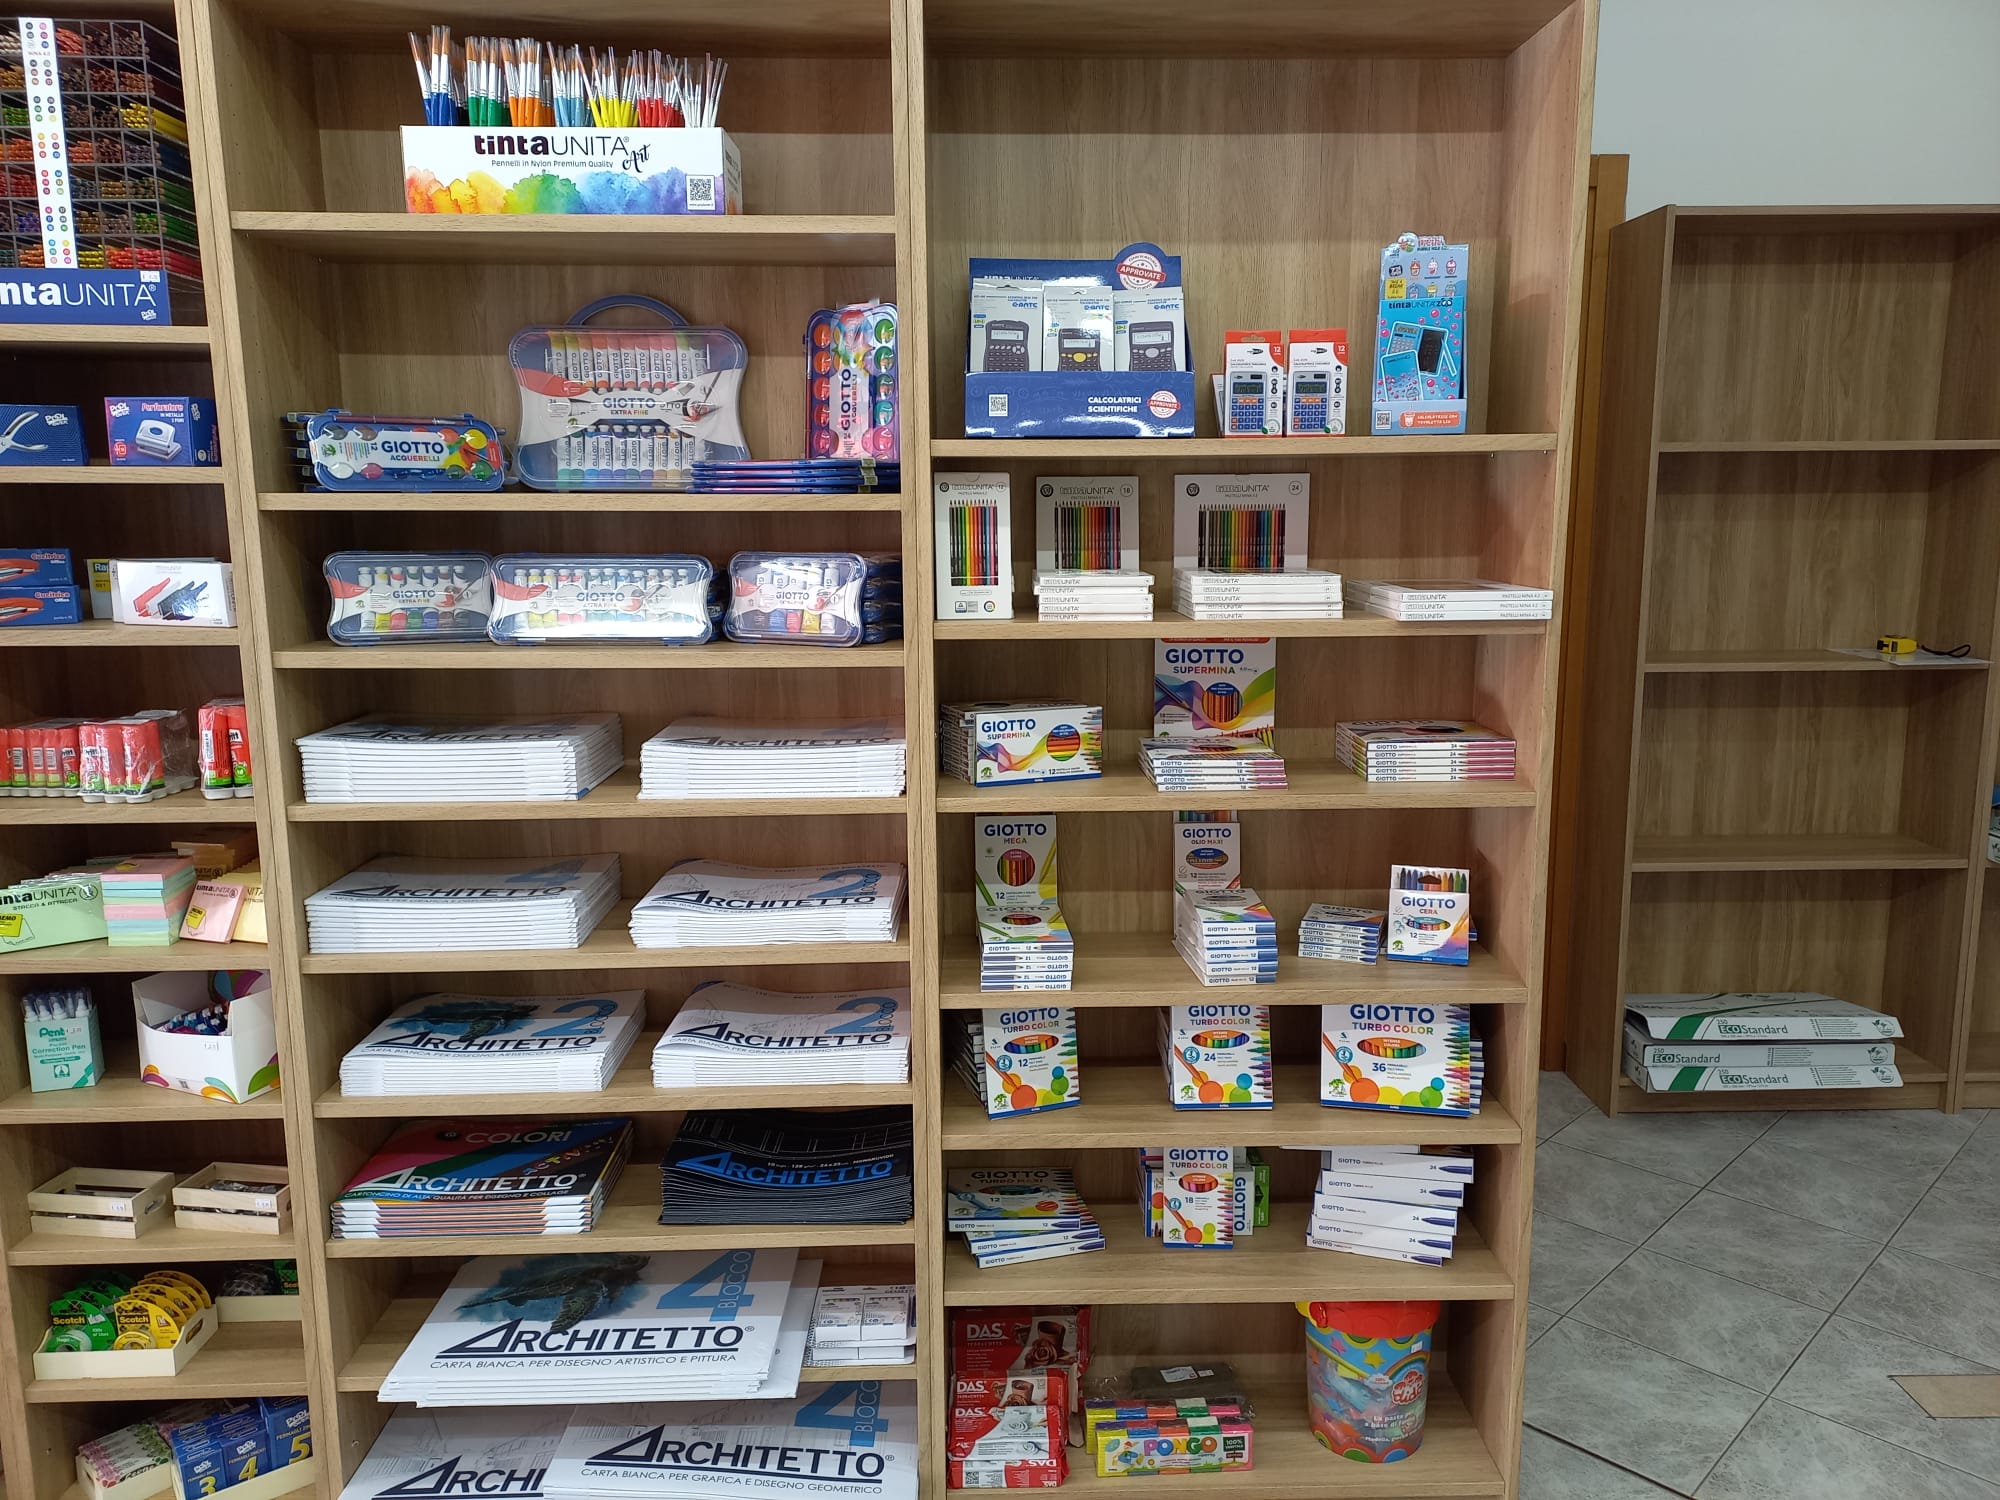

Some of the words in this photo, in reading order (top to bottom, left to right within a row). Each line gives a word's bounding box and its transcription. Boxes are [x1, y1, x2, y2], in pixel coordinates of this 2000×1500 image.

[491, 159, 521, 168] Pennelli
[530, 160, 552, 169] Nylon
[553, 160, 589, 168] Premium
[590, 160, 614, 169] Quality
[1120, 265, 1162, 280] APPROVATE
[603, 397, 656, 409] GIOTTO
[841, 368, 851, 431] GIOTTO
[1087, 396, 1142, 404] CALCOLATRICI
[1087, 405, 1138, 413] SCIENTIFICHE
[381, 440, 444, 454] GIOTTO
[390, 454, 440, 462] ACQUERELLI
[392, 589, 436, 600] GIOTTO
[776, 592, 809, 600] GIOTTO
[1165, 648, 1244, 664] GIOTTO
[1173, 666, 1236, 674] SUPERMINA
[981, 718, 1036, 733] GIOTTO
[987, 732, 1031, 740] SUPERMINA
[984, 823, 1047, 837] GIOTTO
[1182, 828, 1231, 838] GIOTTO
[806, 868, 882, 899] 2
[330, 884, 568, 898] ARCHITETTO
[995, 892, 1005, 900] 12
[651, 890, 876, 909] ARCHITETTO
[1401, 896, 1456, 909] GIOTTO
[531, 999, 619, 1037] 2
[824, 996, 899, 1035] 2
[1000, 1007, 1060, 1025] GIOTTO
[1188, 1005, 1251, 1017] GIOTTO
[1350, 1003, 1435, 1024] GIOTTO
[1002, 1024, 1030, 1034] TURBO
[1031, 1020, 1060, 1030] COLOR
[1352, 1021, 1391, 1033] TURBO
[1393, 1024, 1434, 1036] COLOR
[366, 1030, 599, 1052] ARCHITETTO
[673, 1022, 892, 1048] ARCHITETTO
[747, 1048, 785, 1056] GRAFICA
[1204, 1053, 1216, 1062] 24
[1018, 1058, 1028, 1067] 12
[1372, 1062, 1386, 1072] 36
[465, 1131, 572, 1144] COLORI
[1169, 1148, 1229, 1161] GIOTTO
[1338, 1157, 1361, 1165] GIOTTO
[676, 1151, 893, 1185] ARCHITETTO
[1171, 1161, 1198, 1169] TURBO
[352, 1166, 580, 1192] ARCHITETTO
[971, 1170, 1049, 1179] GIOTTO
[1329, 1180, 1352, 1188] GIOTTO
[345, 1190, 401, 1199] CARTONCINO
[1184, 1196, 1194, 1204] 18
[1234, 1176, 1246, 1232] GIOTTO
[1321, 1204, 1345, 1212] GIOTTO
[656, 1249, 755, 1322] 4
[717, 1251, 752, 1309] BLOCCO
[53, 1316, 85, 1325] Scotch
[119, 1315, 150, 1324] Scotch
[439, 1317, 743, 1354] ARCHITETTO
[966, 1322, 1005, 1339] DAS
[430, 1361, 474, 1369] CARTA
[476, 1360, 525, 1369] BIANCA
[528, 1360, 552, 1368] PER
[554, 1358, 613, 1367] DISEGNO
[615, 1356, 677, 1366] ARTISTICO
[680, 1356, 687, 1364] E
[689, 1354, 737, 1363] PITTURA
[957, 1380, 988, 1393] DAS
[794, 1381, 889, 1447] 4
[955, 1407, 985, 1417] DAS
[288, 1432, 311, 1465] 5
[586, 1423, 886, 1478] ARCHITETTO
[1143, 1436, 1218, 1456] PONGO
[238, 1456, 258, 1481] 4
[1028, 1459, 1057, 1467] DAS
[200, 1476, 217, 1496] 3
[581, 1468, 619, 1478] CARTA
[621, 1470, 666, 1480] BIANCA
[668, 1472, 689, 1481] PER
[691, 1473, 742, 1485] GRAFICA
[745, 1477, 752, 1486] E
[754, 1478, 805, 1491] DISEGNO
[807, 1483, 882, 1495] GEOMETRICO
